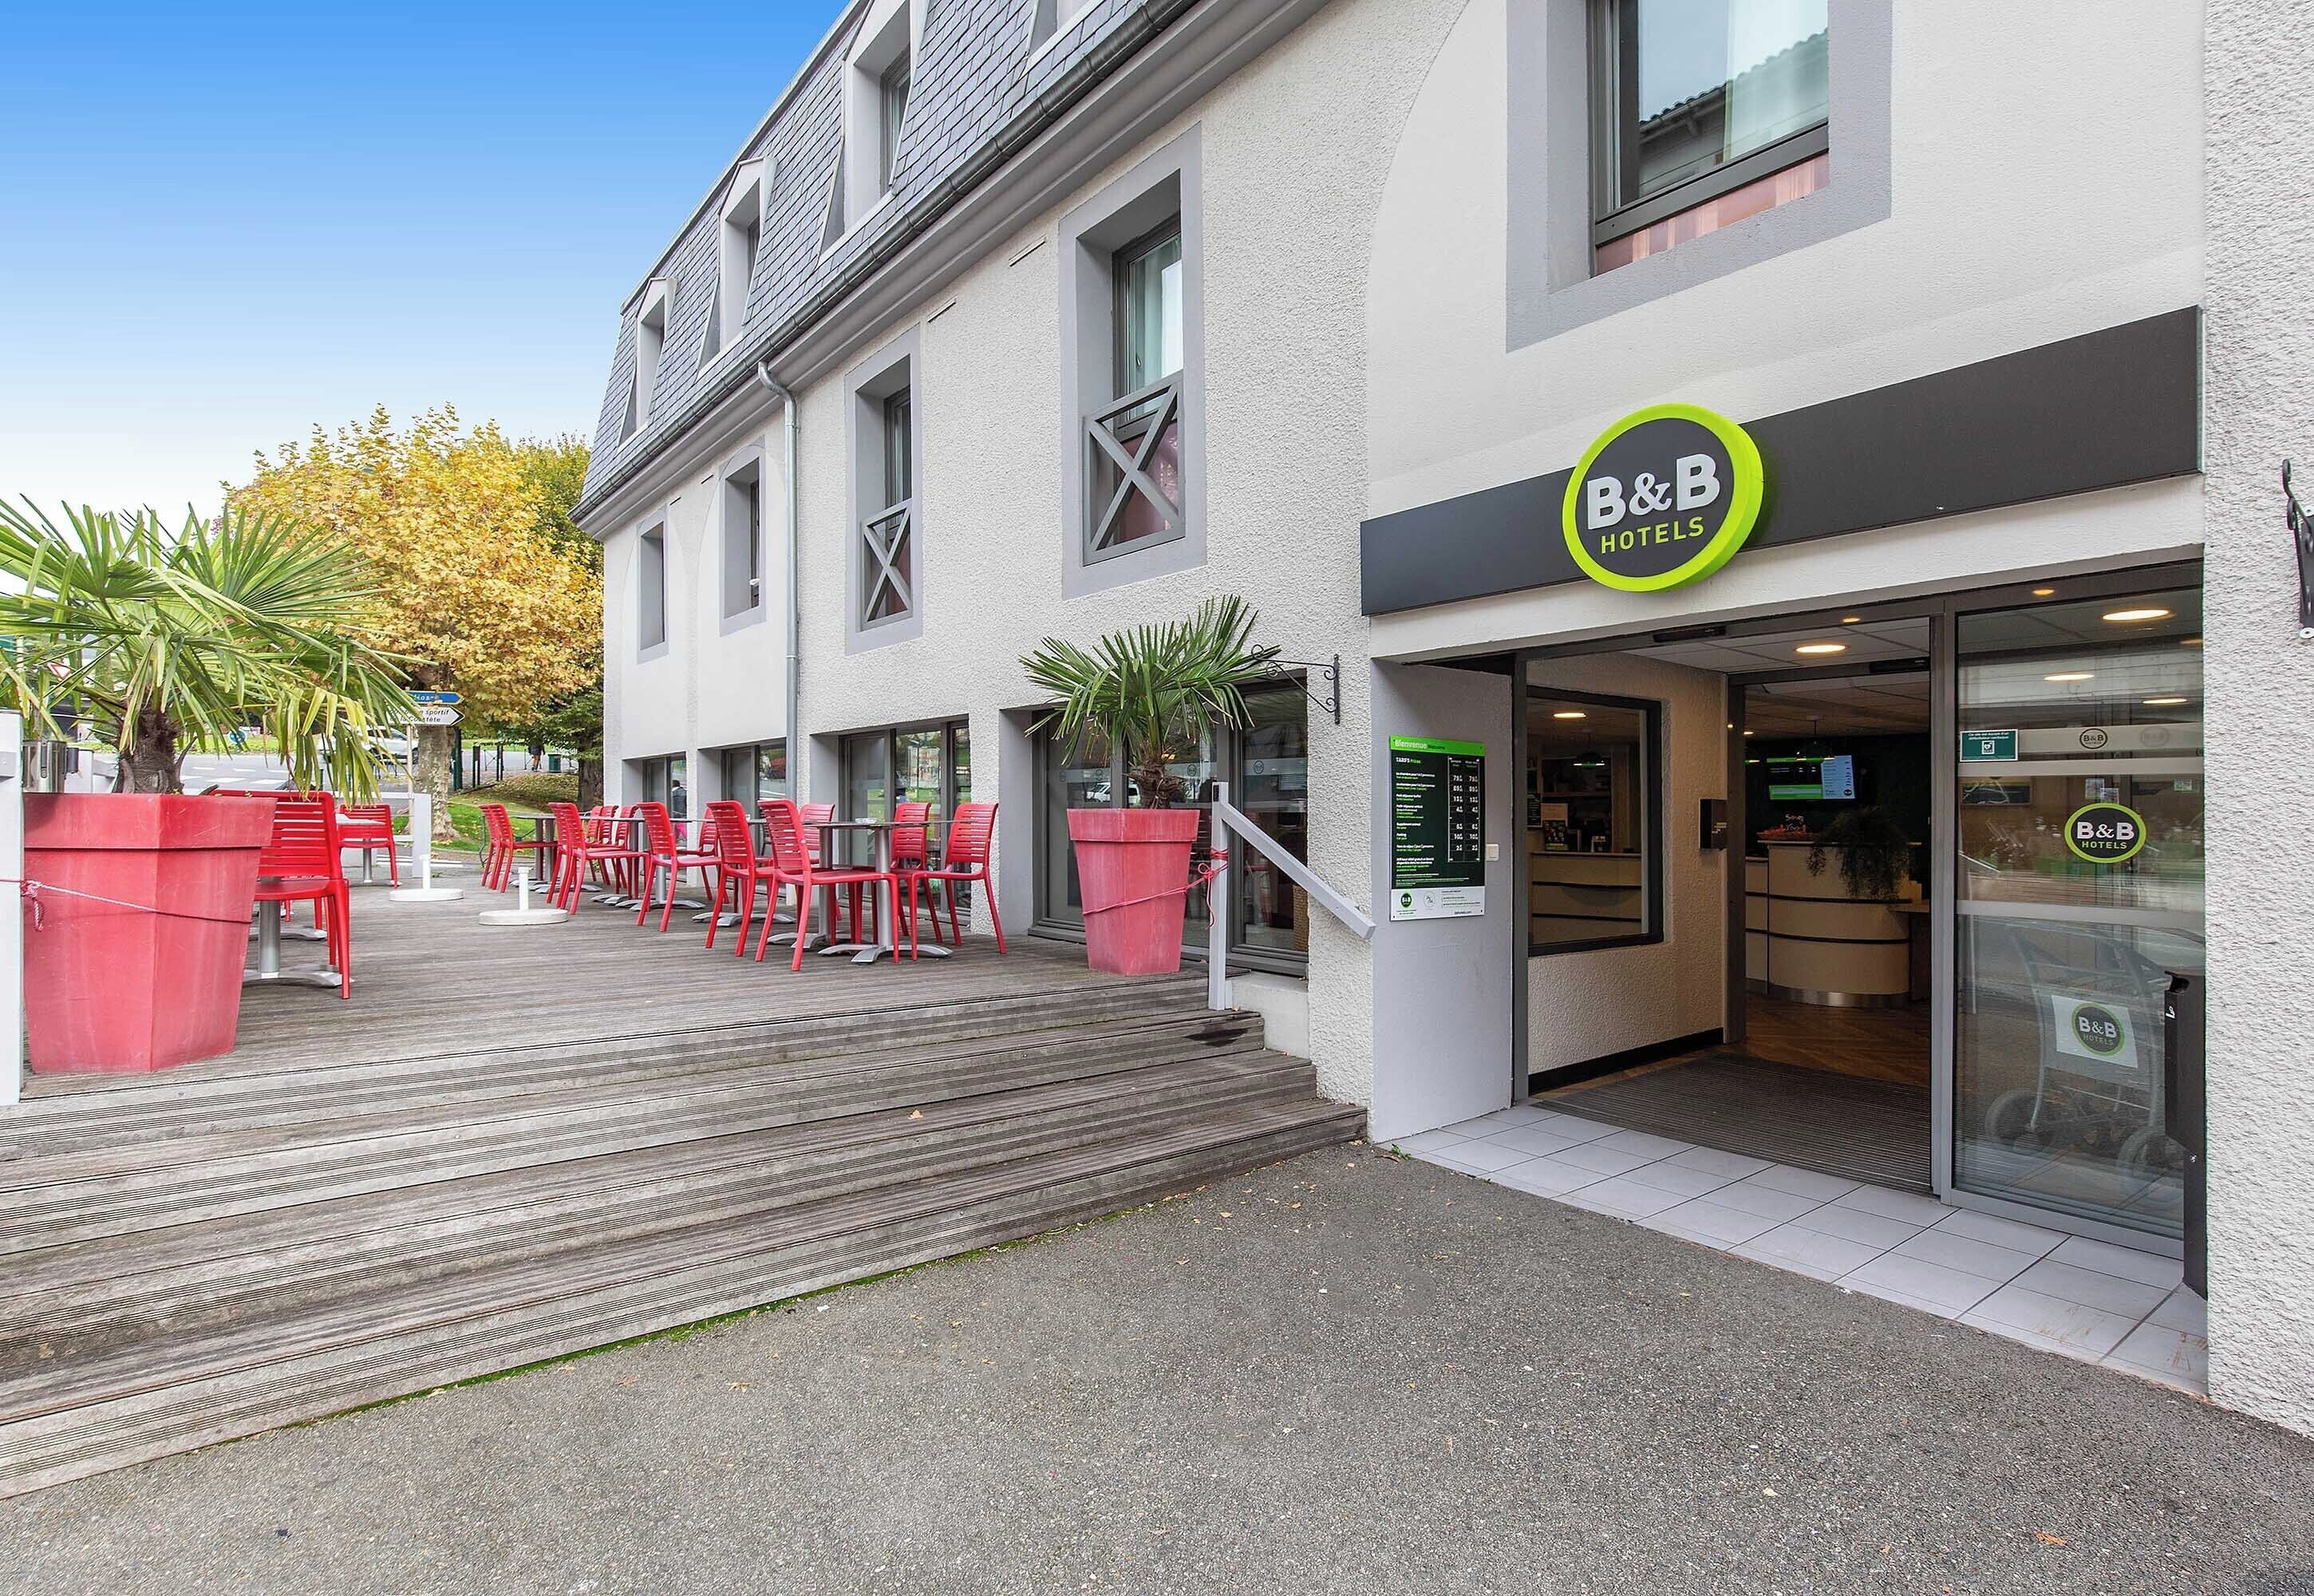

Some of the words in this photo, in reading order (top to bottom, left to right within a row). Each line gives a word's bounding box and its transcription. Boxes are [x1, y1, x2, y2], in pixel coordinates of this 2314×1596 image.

[1587, 453, 1720, 531] B&B
[1600, 516, 1704, 555] HOTELS
[1395, 739, 1428, 749] Bienvenue
[2077, 821, 2135, 840] B&B
[2078, 1016, 2117, 1038] B&B
[2083, 1033, 2114, 1046] HOTELS
